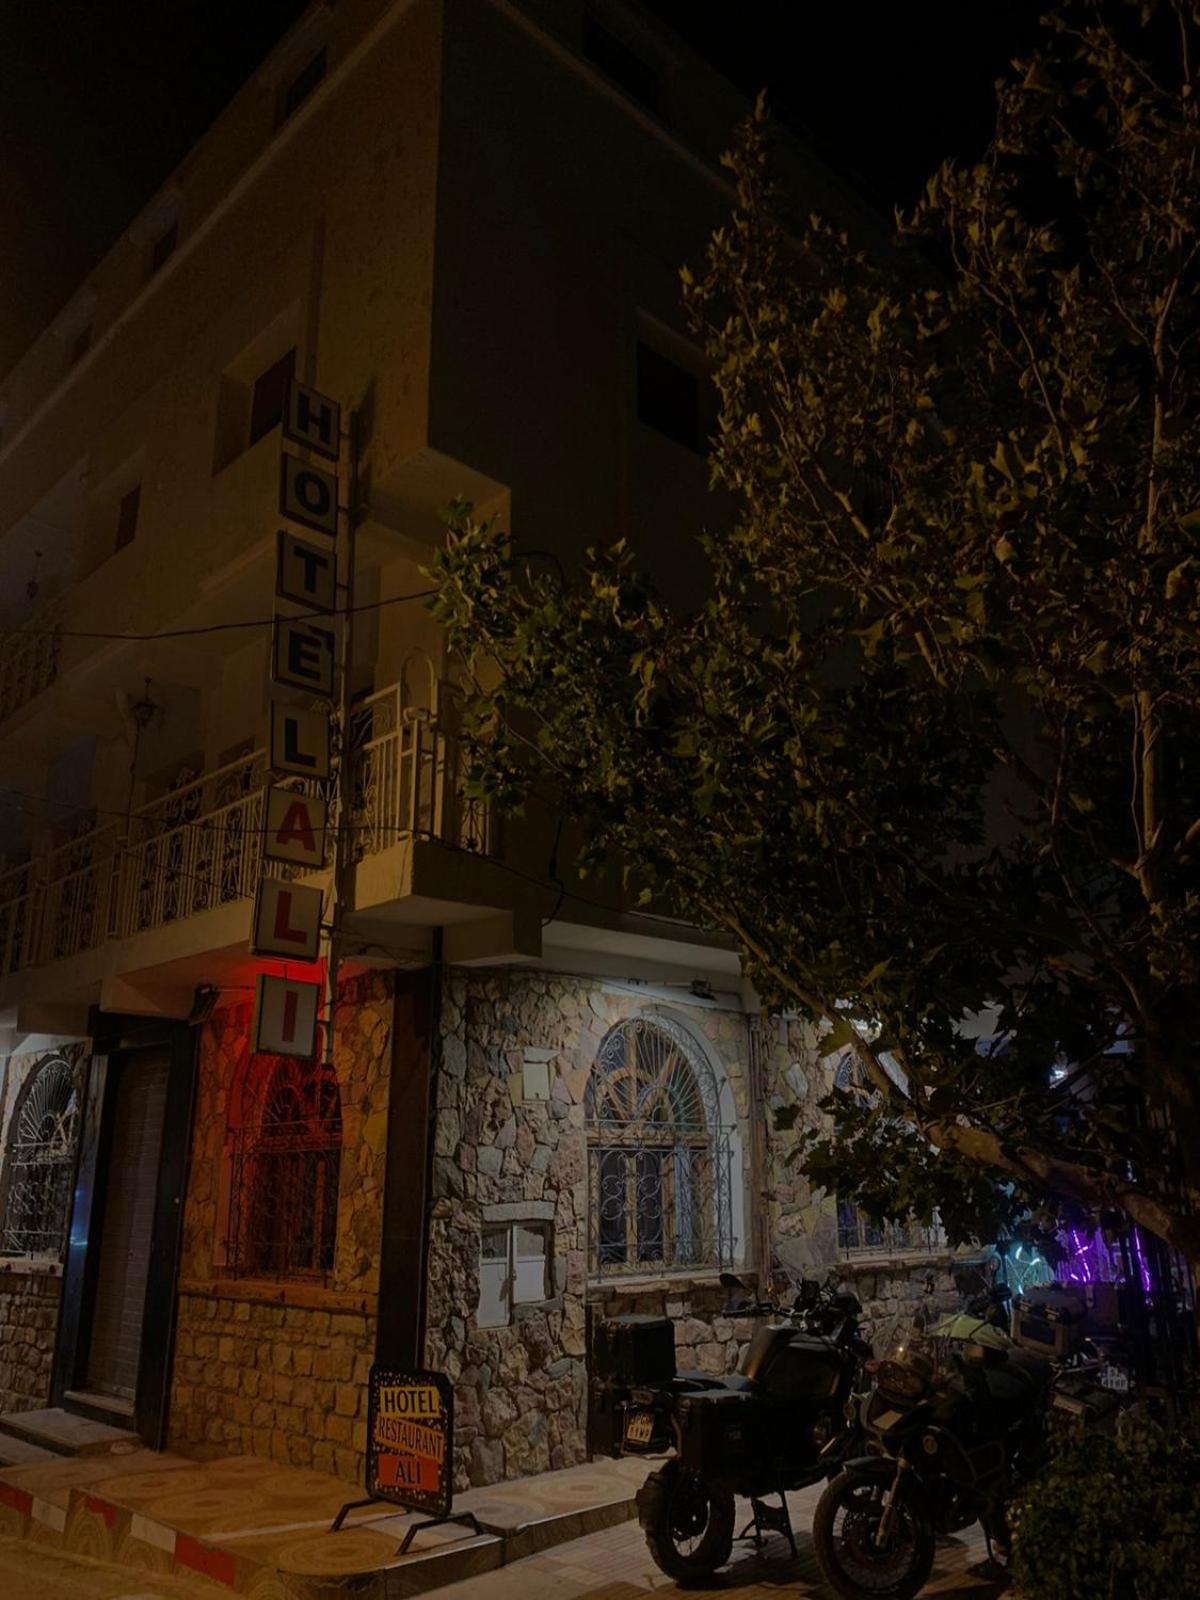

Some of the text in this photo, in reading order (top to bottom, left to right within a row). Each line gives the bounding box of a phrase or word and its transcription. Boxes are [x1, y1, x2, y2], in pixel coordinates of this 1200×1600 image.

[274, 391, 331, 1042] HOTEL ALI
[384, 1390, 437, 1413] HOTEL
[379, 1417, 442, 1459] RESTAURANT
[395, 1461, 420, 1484] ALI
